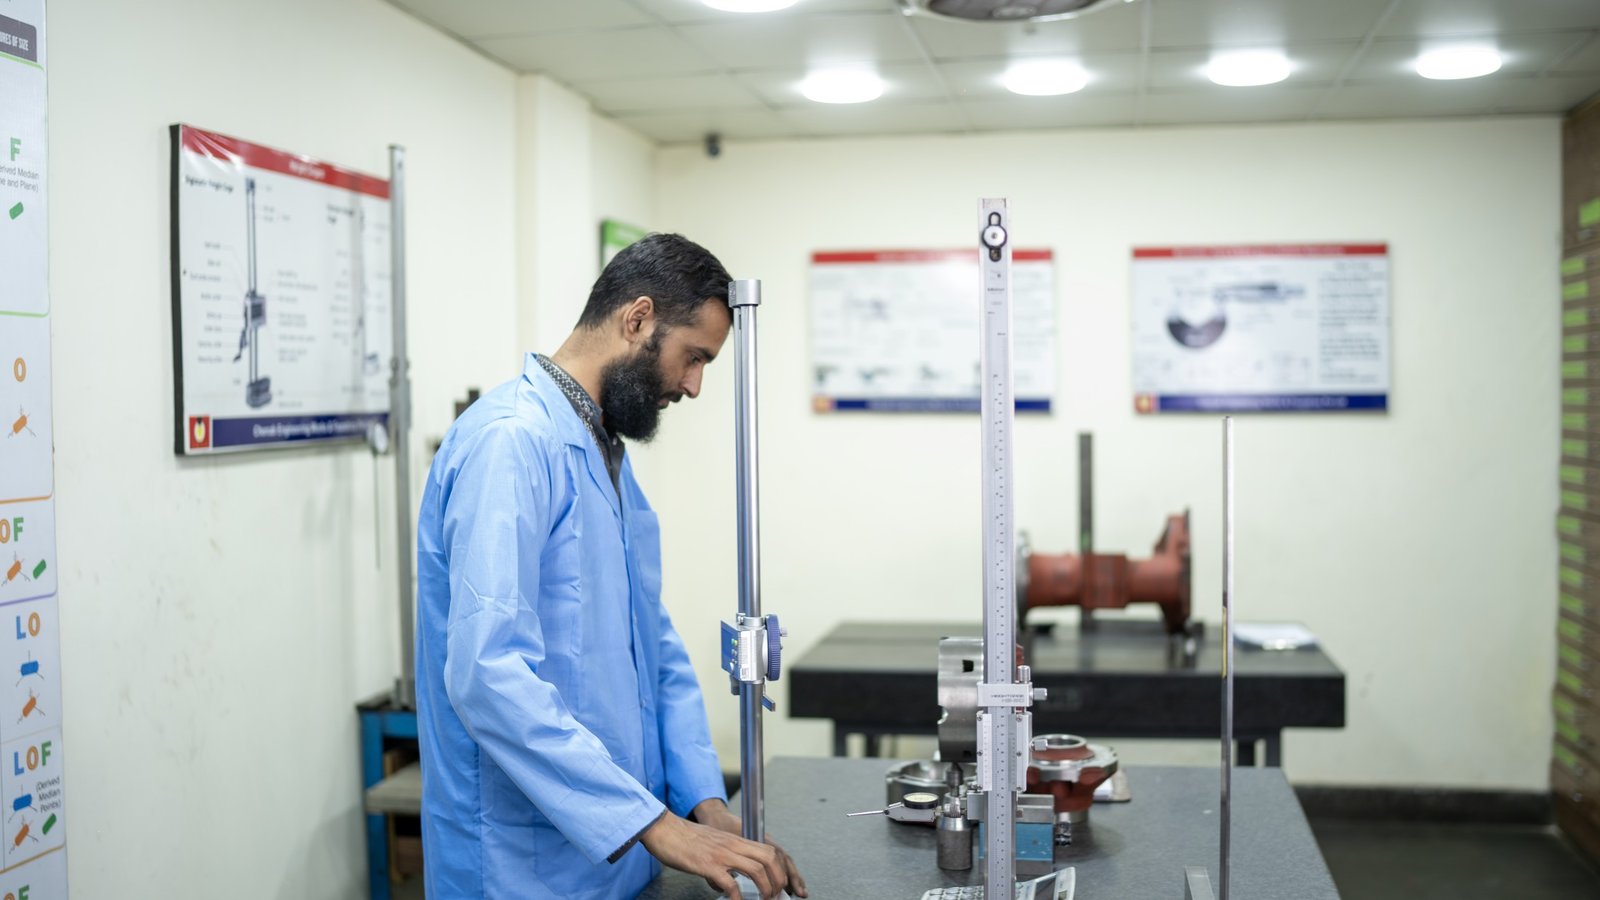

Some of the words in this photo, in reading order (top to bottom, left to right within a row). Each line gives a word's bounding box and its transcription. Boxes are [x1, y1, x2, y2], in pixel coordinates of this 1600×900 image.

[12, 35, 18, 47] OF
[19, 37, 29, 51] SIZE
[10, 137, 21, 161] F
[17, 167, 39, 180] Median
[16, 611, 40, 640] LO
[14, 740, 52, 776] LOF
[39, 788, 61, 801] Median
